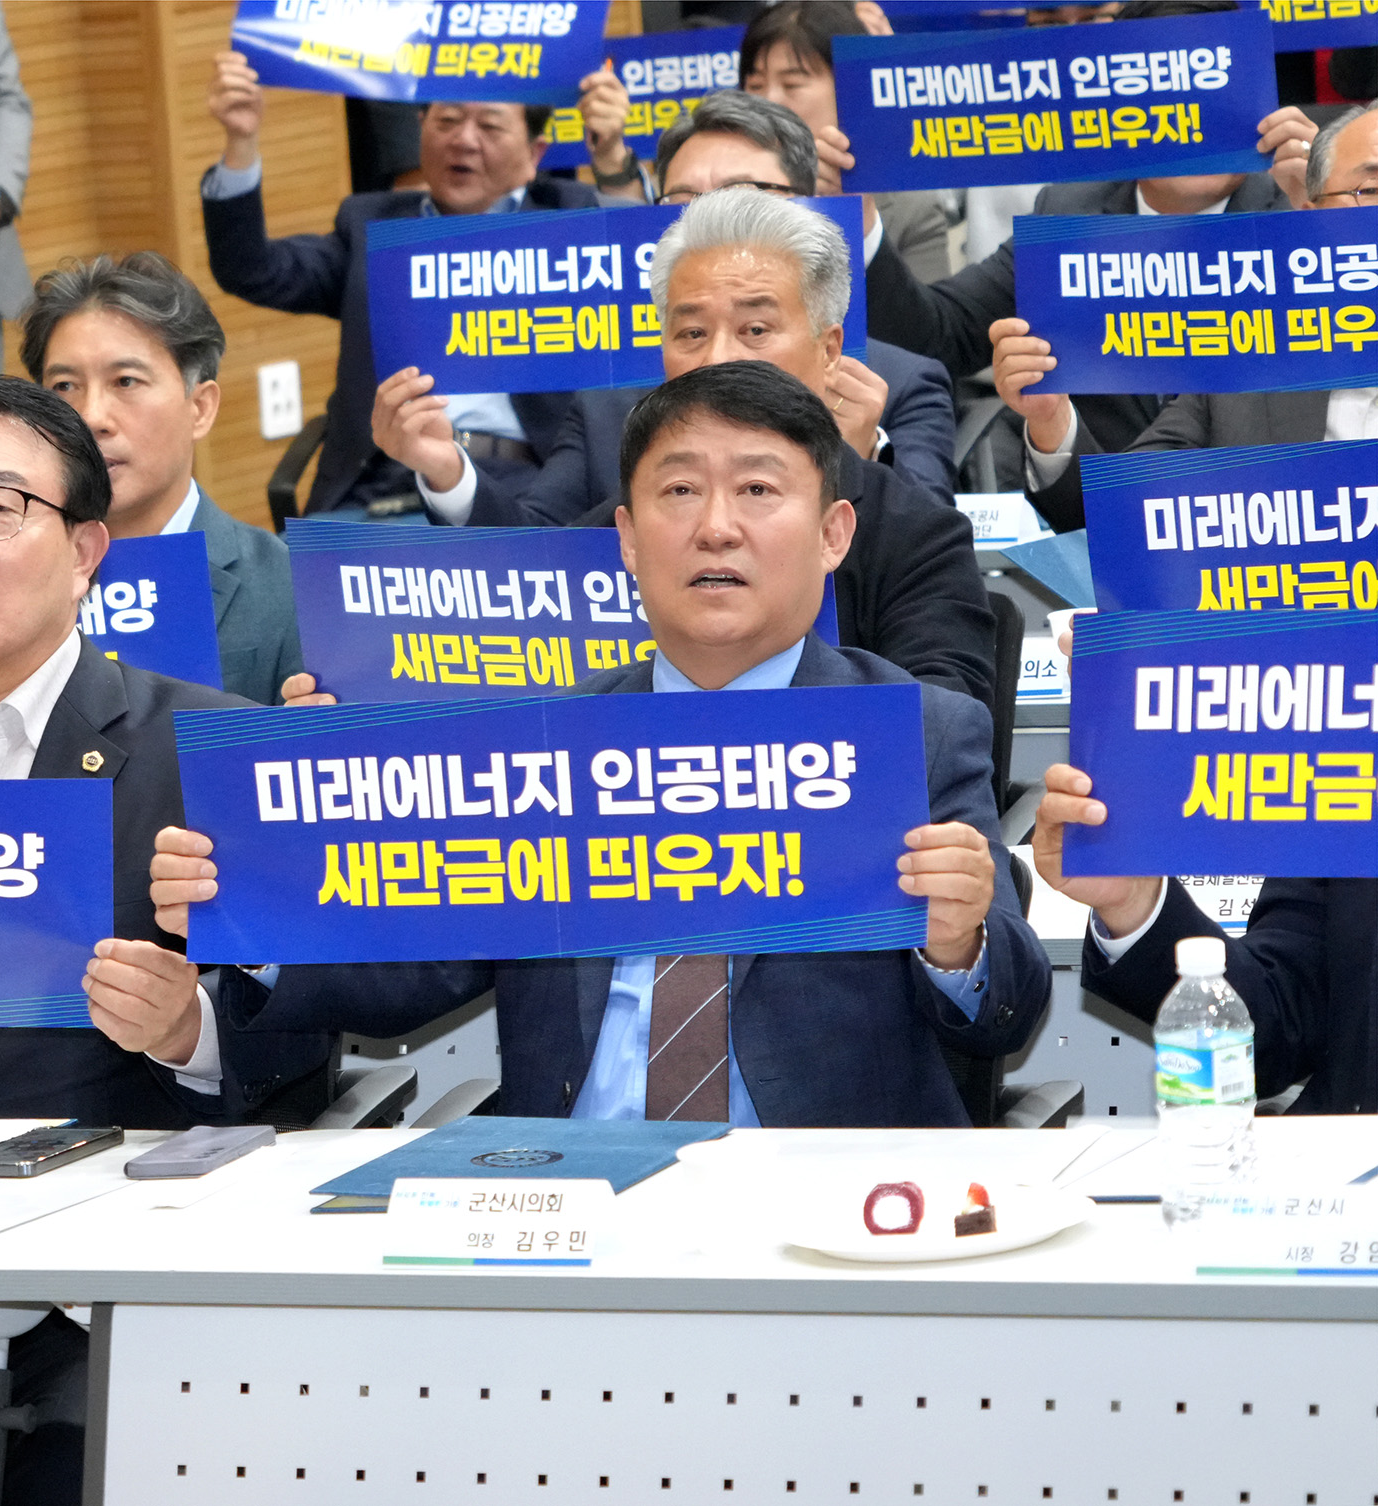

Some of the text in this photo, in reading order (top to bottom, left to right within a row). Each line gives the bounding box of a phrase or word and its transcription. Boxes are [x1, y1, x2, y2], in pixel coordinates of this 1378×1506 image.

[447, 1, 578, 37] 인공태양
[434, 43, 542, 78] 띄우자!
[871, 46, 1232, 108] 미래에너지 인공태양
[910, 103, 1204, 158] 새만금에 띄우자!
[410, 244, 623, 299] 미래에너지
[1059, 249, 1276, 299] 미래에너지
[446, 304, 621, 356] 새만금에
[1102, 309, 1276, 357] 새만금에
[339, 564, 573, 621] 미래에너지
[391, 633, 576, 687] 새만금에
[254, 740, 858, 824] 미래에너지 인공태양
[318, 831, 805, 907] 새만금에 띄우자!
[468, 1192, 564, 1213] 군산시의회
[467, 1232, 495, 1248] 의장
[1285, 1246, 1314, 1262] 시장
